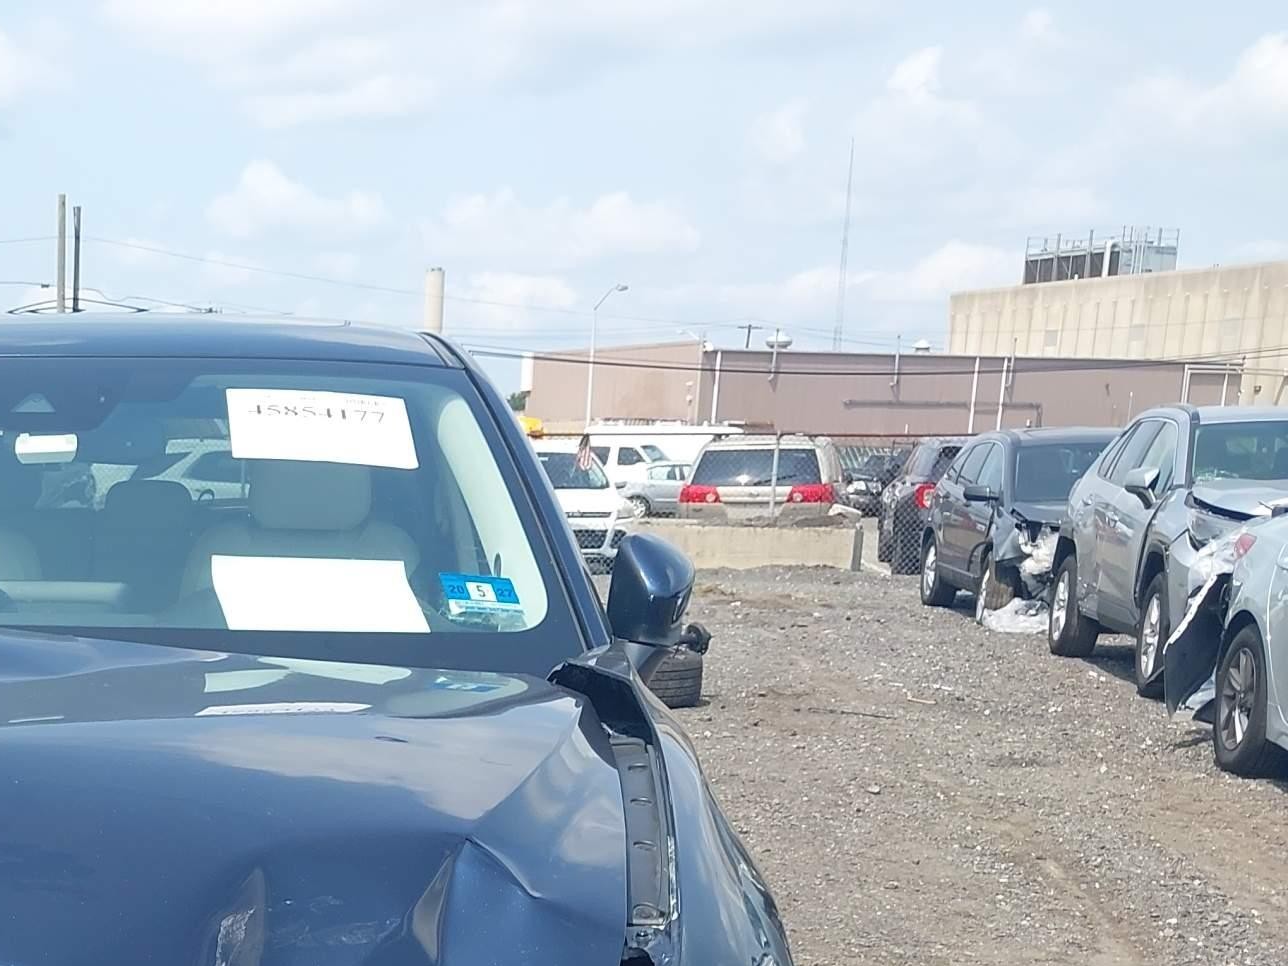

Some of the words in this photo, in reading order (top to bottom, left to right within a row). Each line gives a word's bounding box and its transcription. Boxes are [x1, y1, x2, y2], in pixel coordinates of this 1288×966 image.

[448, 584, 465, 595] 20
[475, 584, 487, 598] 5
[496, 588, 513, 598] 27
